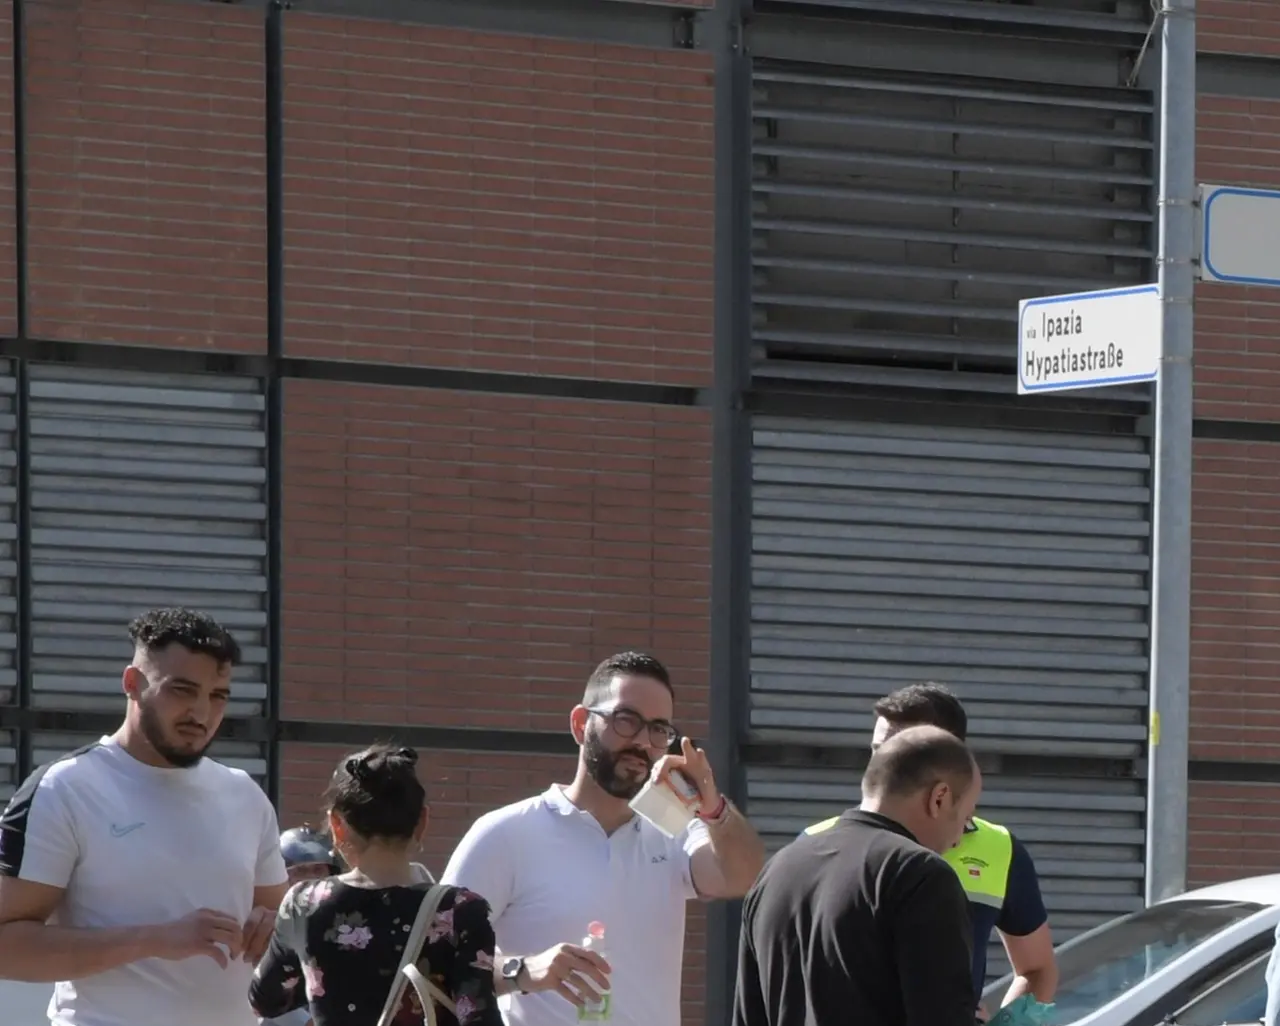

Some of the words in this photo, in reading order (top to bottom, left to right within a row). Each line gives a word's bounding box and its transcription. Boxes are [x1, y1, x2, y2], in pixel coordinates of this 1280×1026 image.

[1026, 327, 1037, 339] via
[1042, 308, 1082, 342] Ipazia
[1025, 342, 1124, 381] Hypatiastraße
